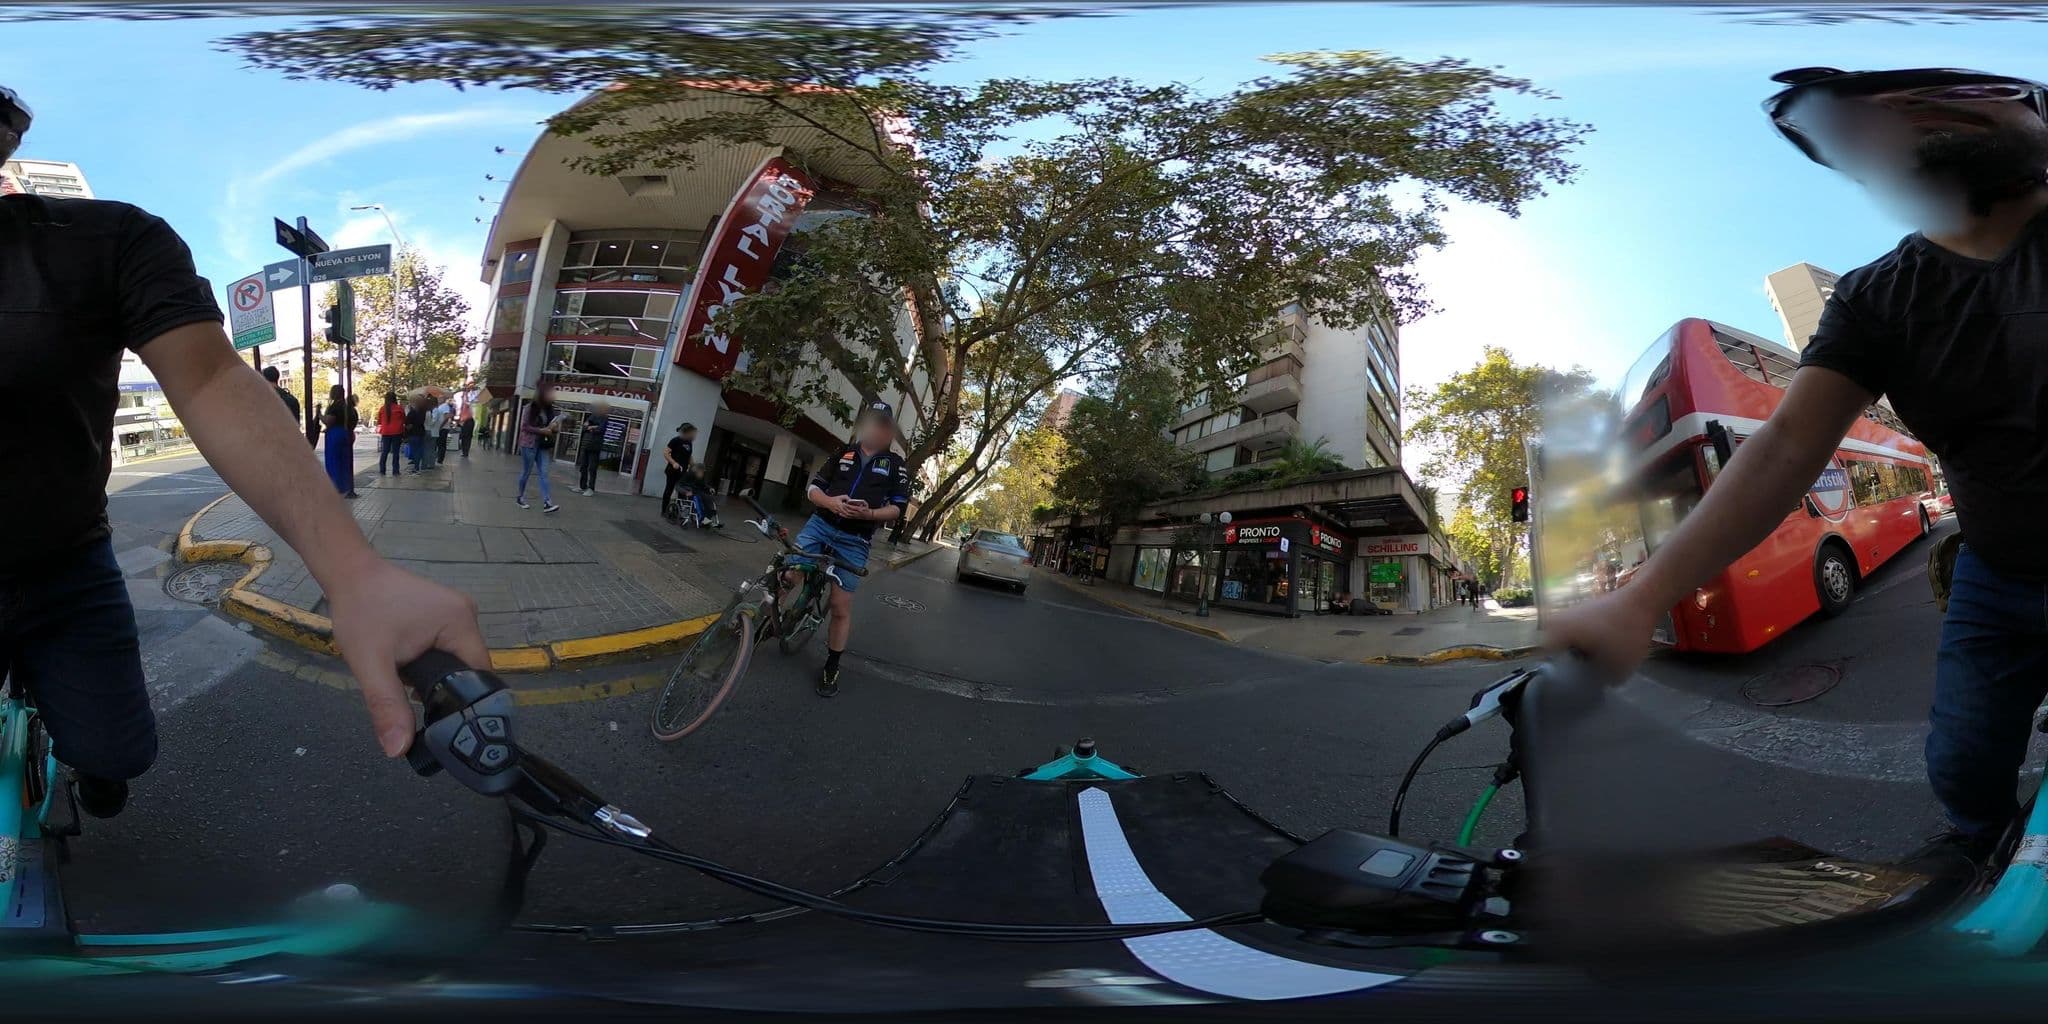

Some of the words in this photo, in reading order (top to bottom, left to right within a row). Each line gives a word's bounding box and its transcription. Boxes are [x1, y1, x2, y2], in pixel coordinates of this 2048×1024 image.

[737, 174, 801, 260] PORTAL
[315, 258, 343, 268] NUEVA
[344, 255, 356, 264] DE
[358, 252, 381, 262] LYON
[1240, 526, 1280, 537] PRONTO
[1320, 531, 1342, 548] PRONTO
[1367, 542, 1418, 554] SCHILLING
